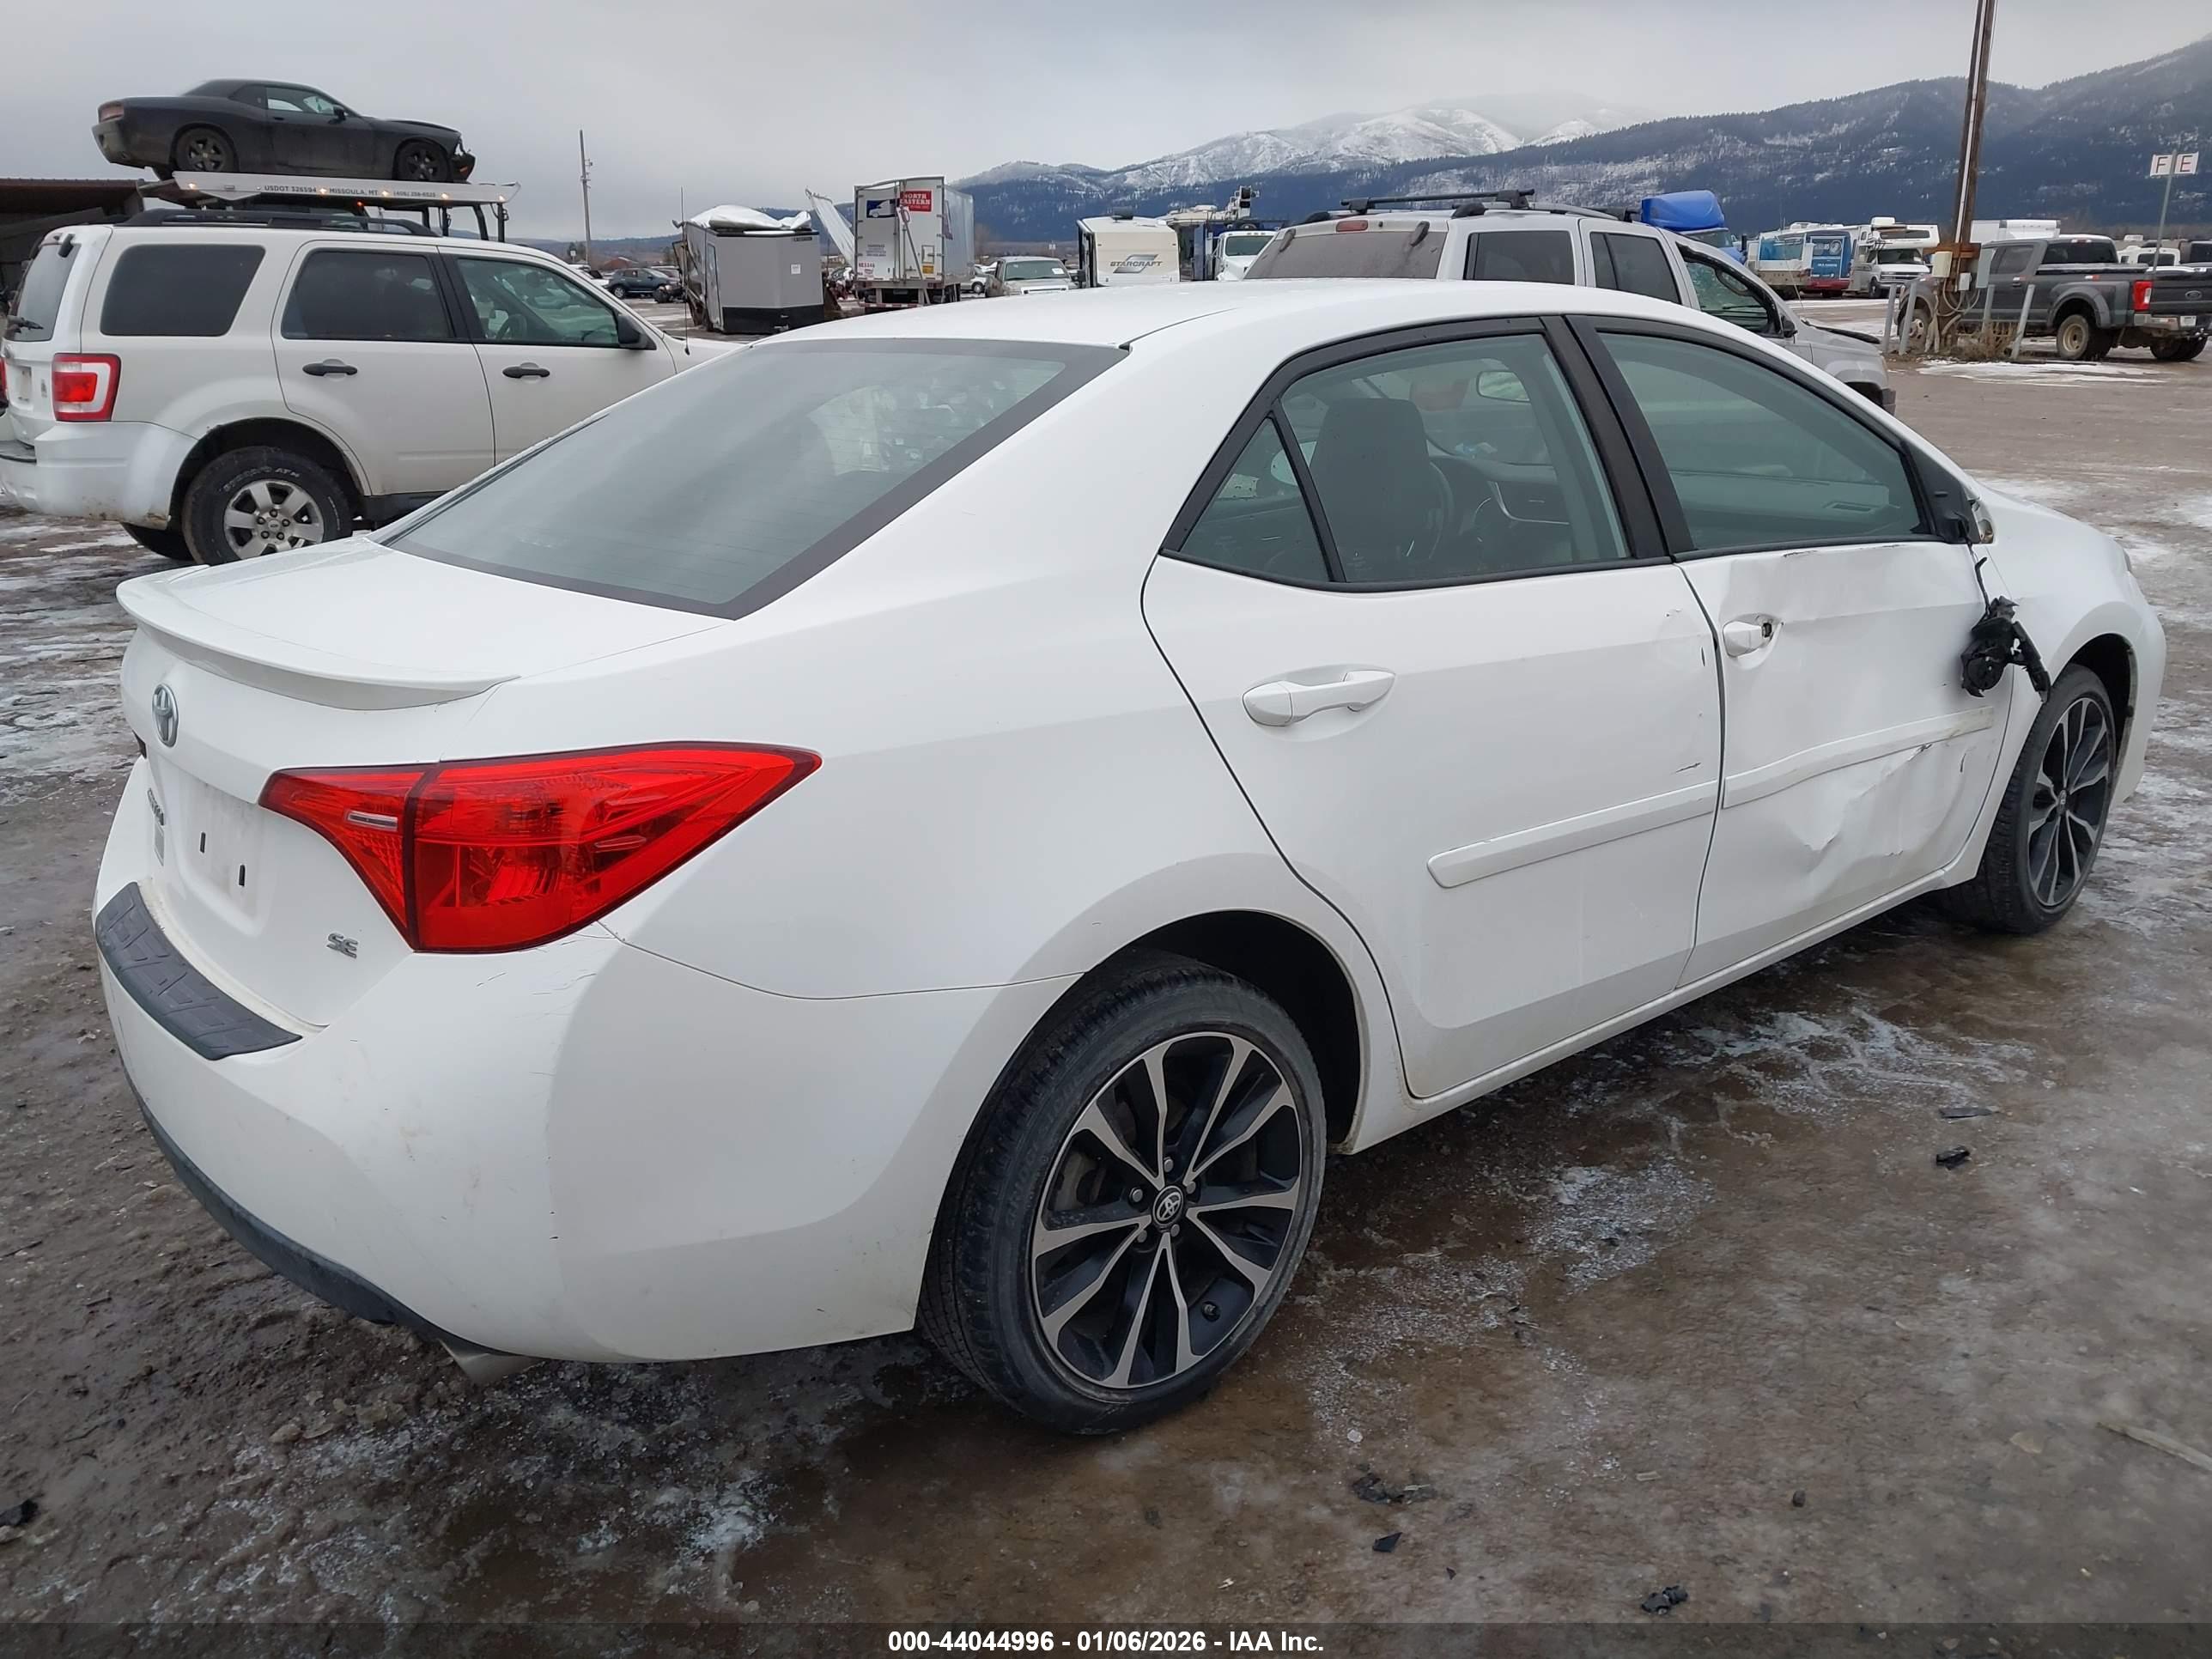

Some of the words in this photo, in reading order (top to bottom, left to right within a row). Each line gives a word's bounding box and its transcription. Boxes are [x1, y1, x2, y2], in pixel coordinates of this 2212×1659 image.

[2155, 156, 2168, 173] F
[2179, 155, 2193, 173] E
[326, 933, 358, 959] SE
